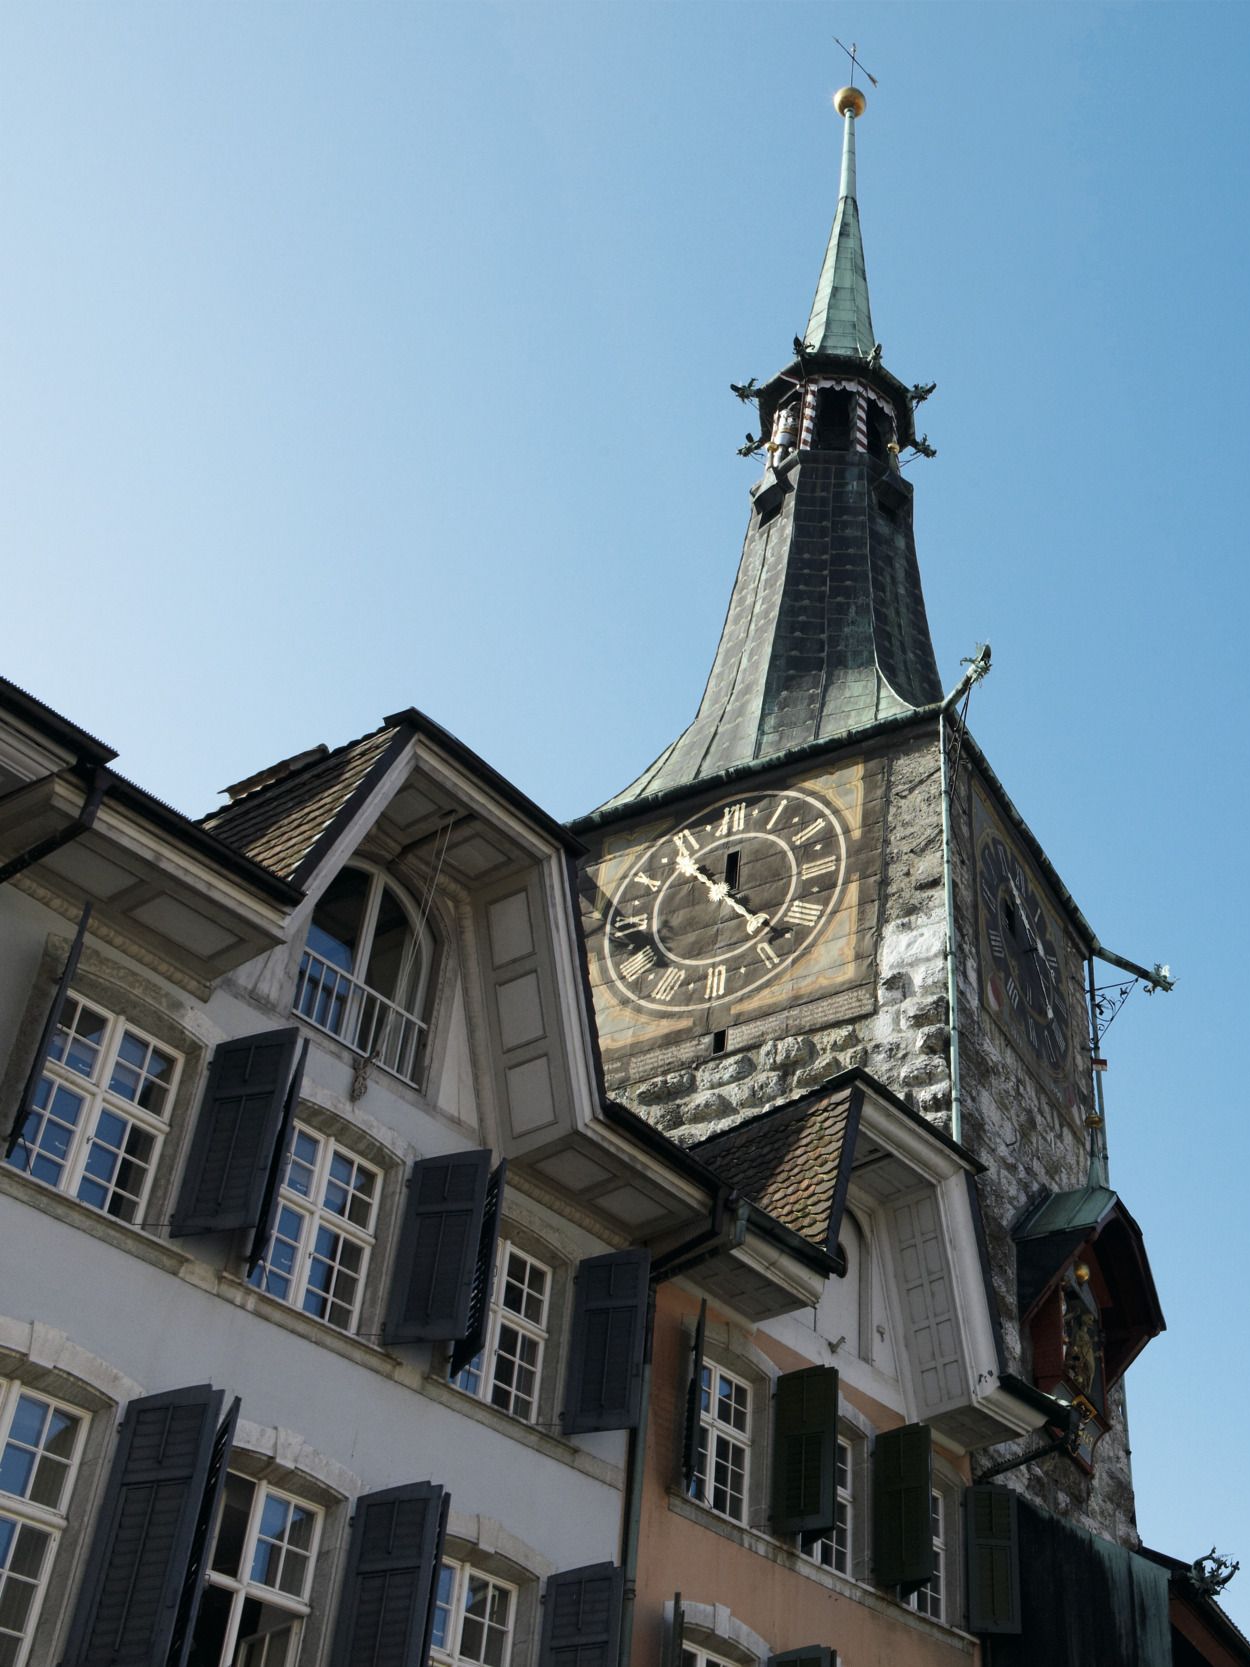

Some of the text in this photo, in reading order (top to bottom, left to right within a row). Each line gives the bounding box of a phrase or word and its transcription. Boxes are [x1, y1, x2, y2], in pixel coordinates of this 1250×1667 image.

[715, 802, 746, 837] XII
[792, 818, 826, 845] II
[801, 855, 837, 880] III
[634, 871, 661, 892] X
[614, 913, 648, 937] IX
[784, 901, 823, 926] IIII
[619, 945, 657, 982] VIII
[651, 967, 686, 1001] VII
